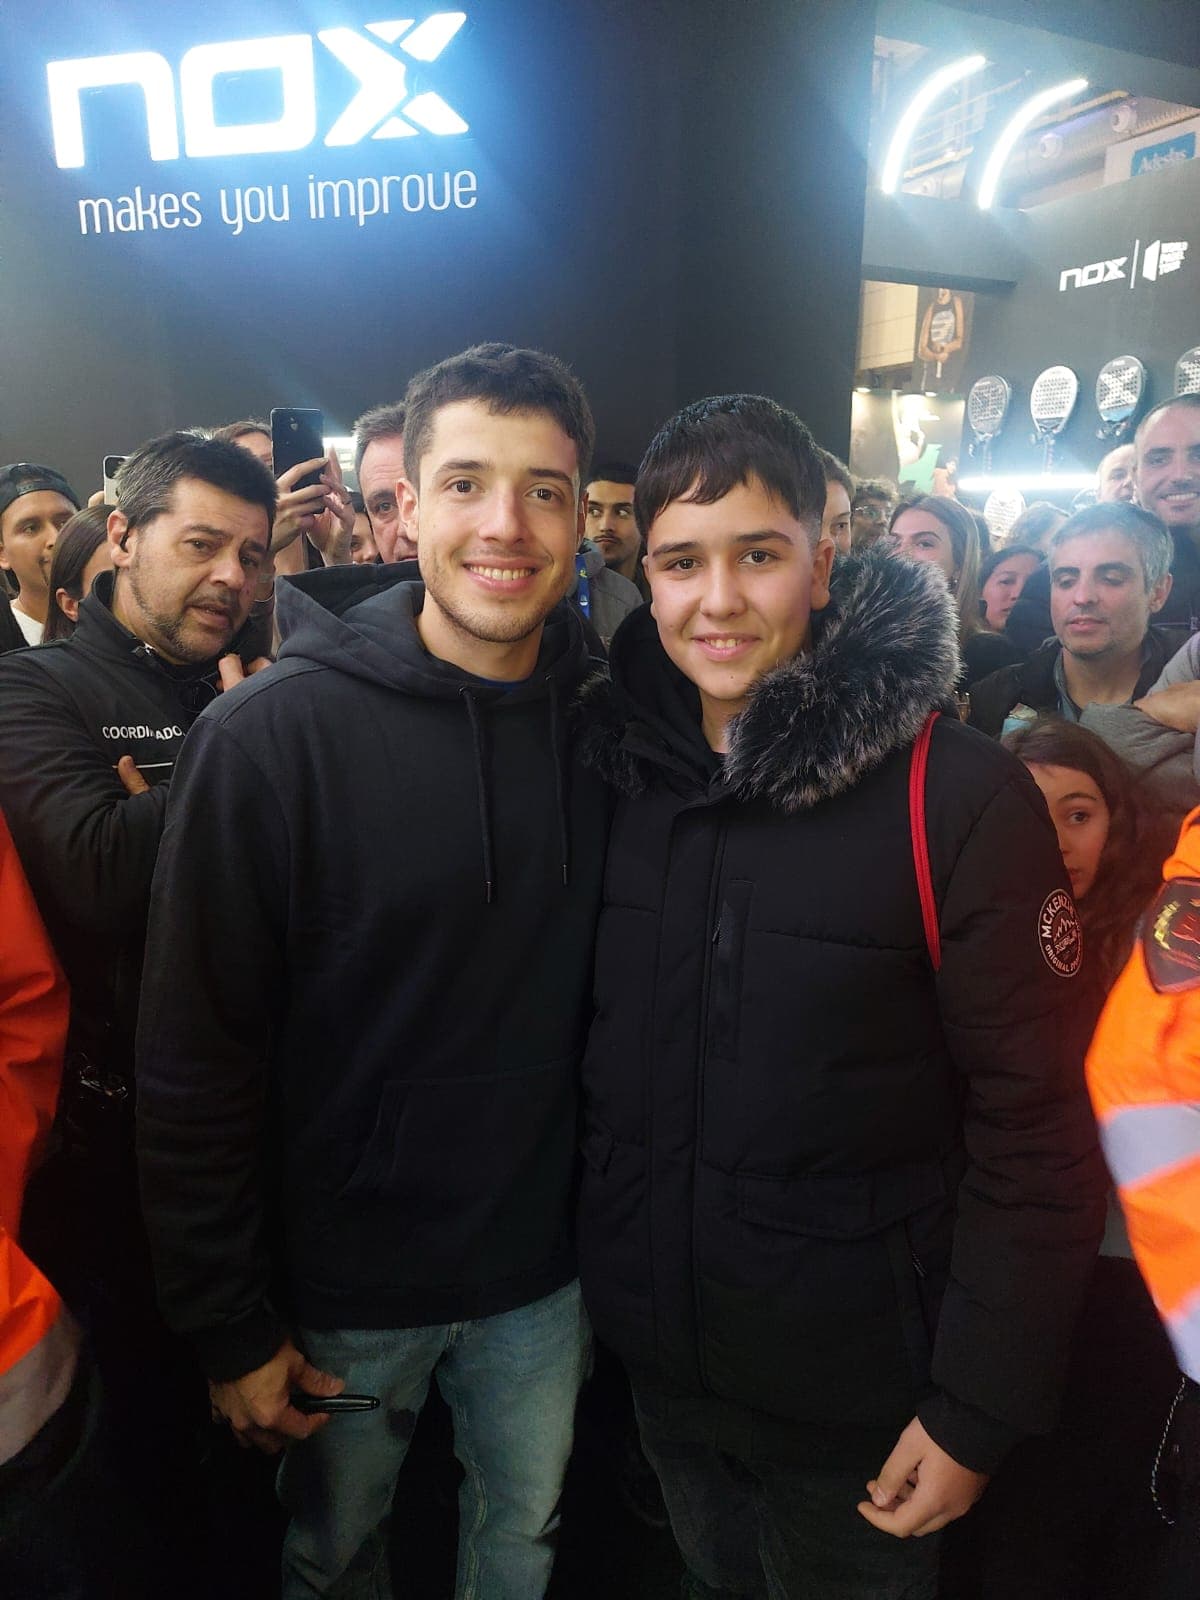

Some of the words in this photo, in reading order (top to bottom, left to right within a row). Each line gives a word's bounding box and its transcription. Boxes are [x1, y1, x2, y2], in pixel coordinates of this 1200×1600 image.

[78, 186, 202, 235] makes
[220, 184, 290, 235] you
[308, 170, 477, 227] improve
[102, 725, 186, 741] COORDIADO
[1044, 944, 1070, 972] ORIGINAL
